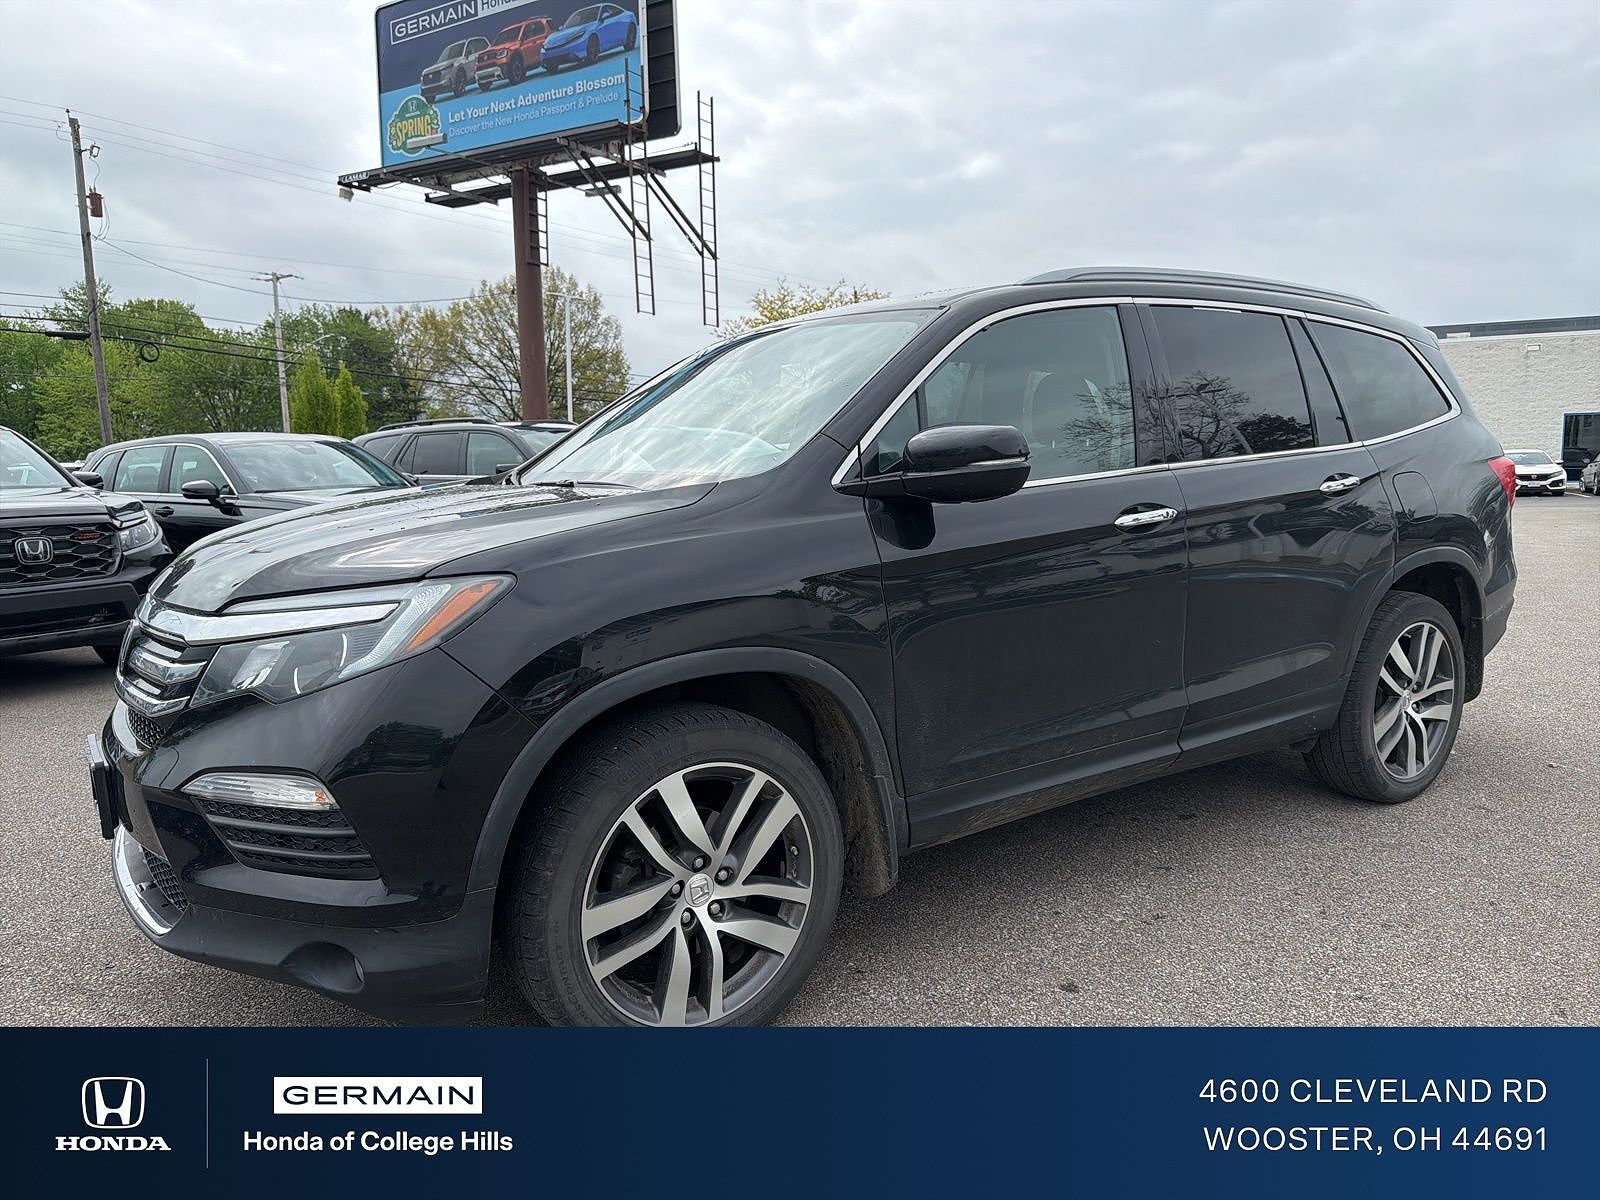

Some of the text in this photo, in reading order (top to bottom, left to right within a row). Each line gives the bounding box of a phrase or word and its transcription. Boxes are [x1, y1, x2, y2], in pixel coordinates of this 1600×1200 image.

[394, 0, 475, 37] GERMAIN
[448, 74, 625, 123] Let Your Next Adventure Blossom
[449, 92, 619, 137] Discover the New Honda Passport & Prelude
[396, 114, 431, 147] SPRING
